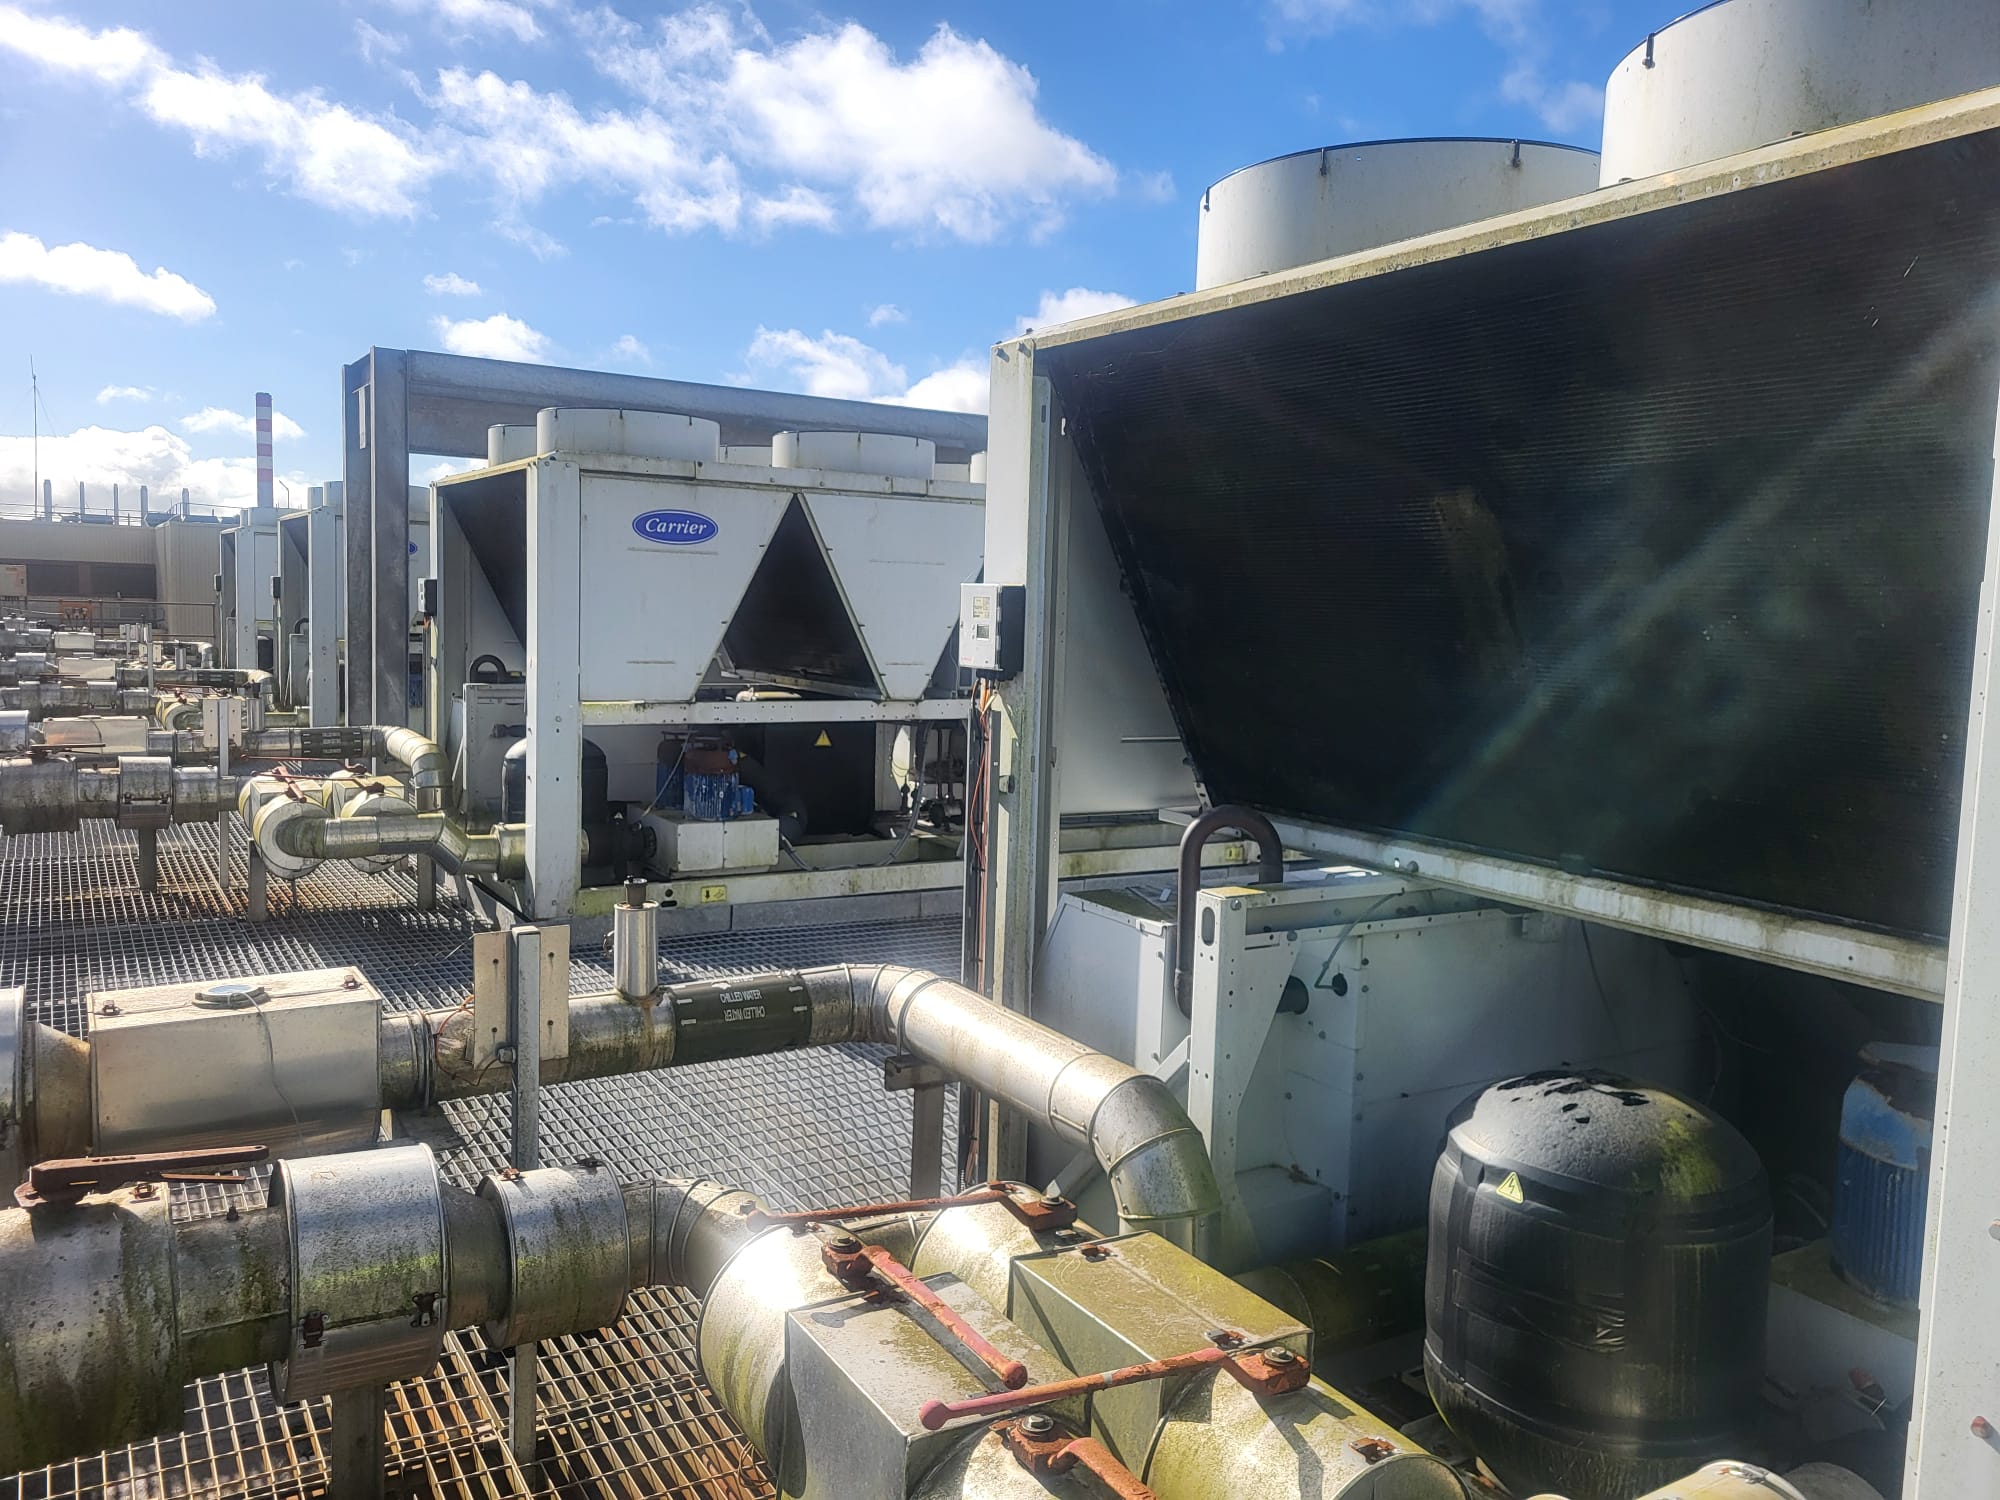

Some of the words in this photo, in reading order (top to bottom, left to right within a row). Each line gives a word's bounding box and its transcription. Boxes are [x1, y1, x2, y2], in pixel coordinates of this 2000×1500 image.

[645, 518, 707, 535] Carrier
[720, 991, 743, 1004] CHILLED
[743, 989, 763, 1001] WATER
[743, 1005, 766, 1019] CHILLED
